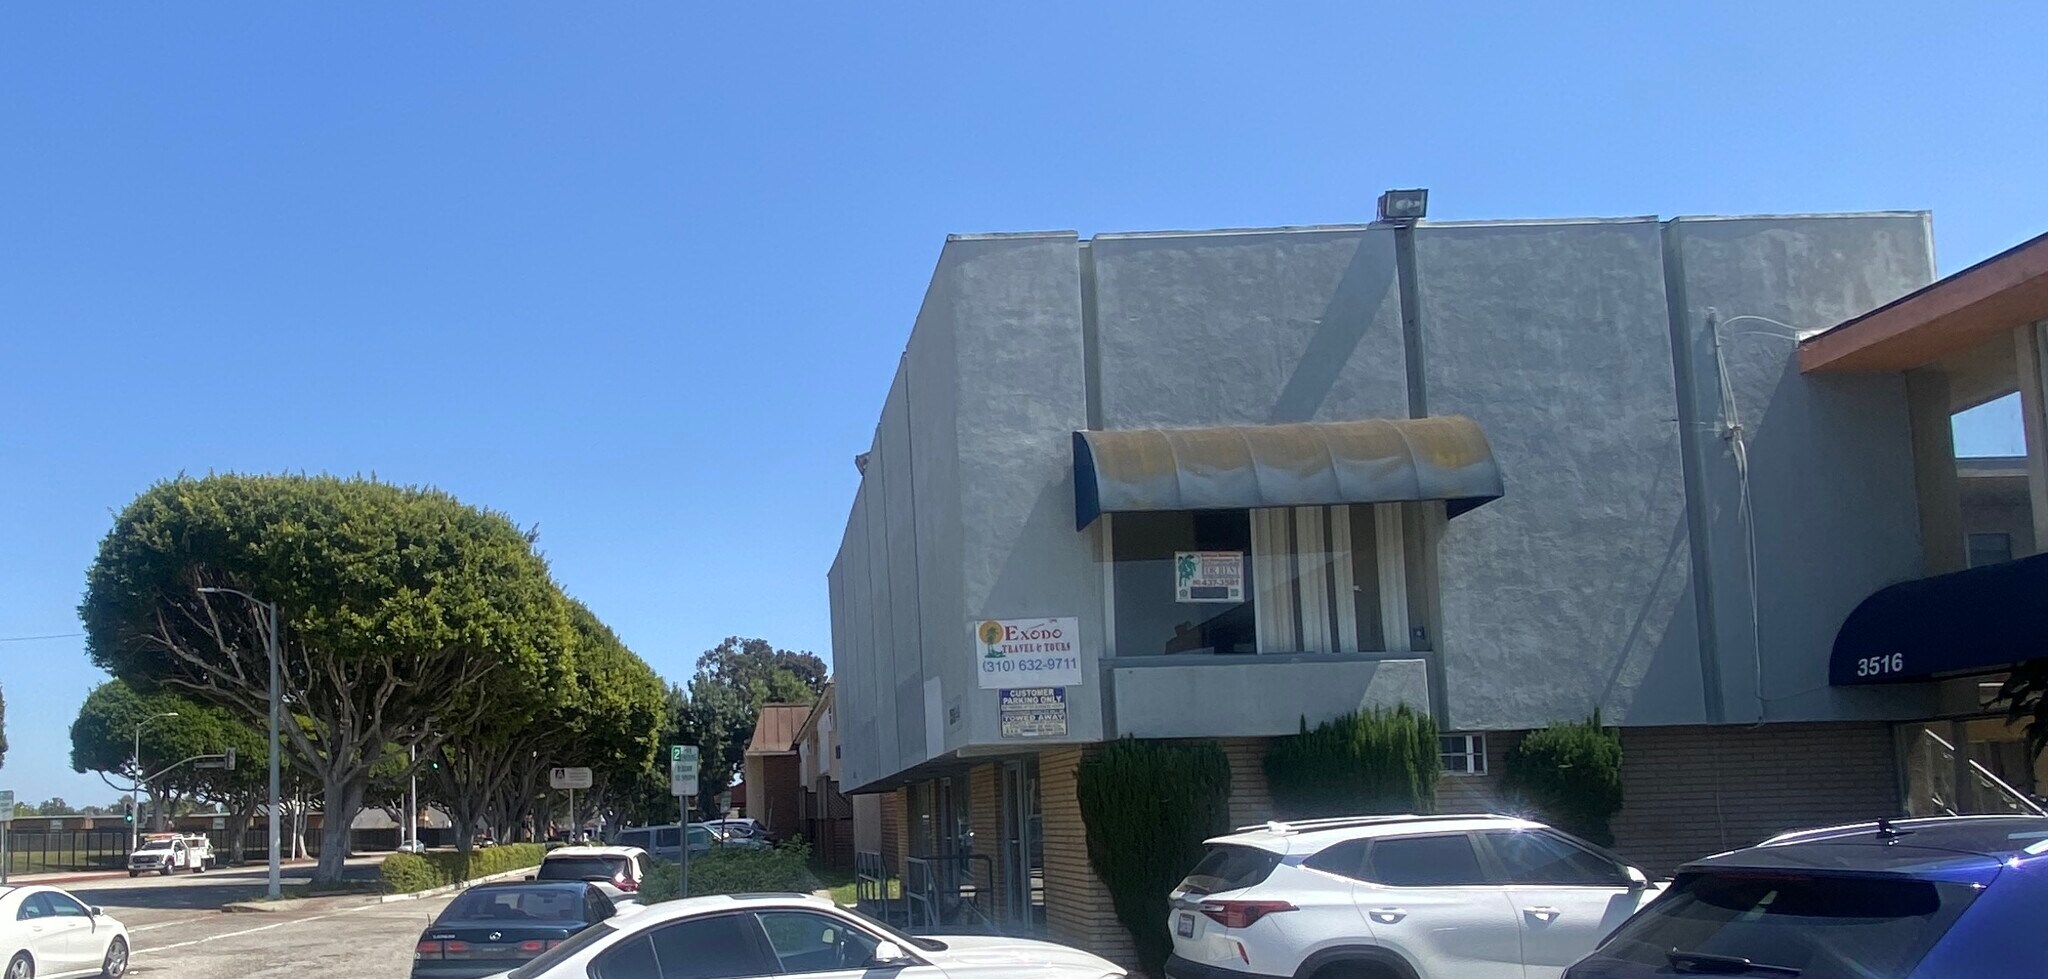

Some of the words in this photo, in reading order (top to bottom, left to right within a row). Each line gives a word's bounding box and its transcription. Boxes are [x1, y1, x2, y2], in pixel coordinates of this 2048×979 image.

[1002, 644, 1034, 653] TRAVEL
[1037, 644, 1042, 653] &
[1044, 642, 1071, 652] TOURS
[982, 659, 1015, 672] (310)
[1019, 658, 1077, 671] 632-9711
[1857, 652, 1903, 677] 3516
[1009, 688, 1054, 697] CUSTOMER
[1040, 696, 1062, 704] ONLY
[673, 749, 680, 760] 2
